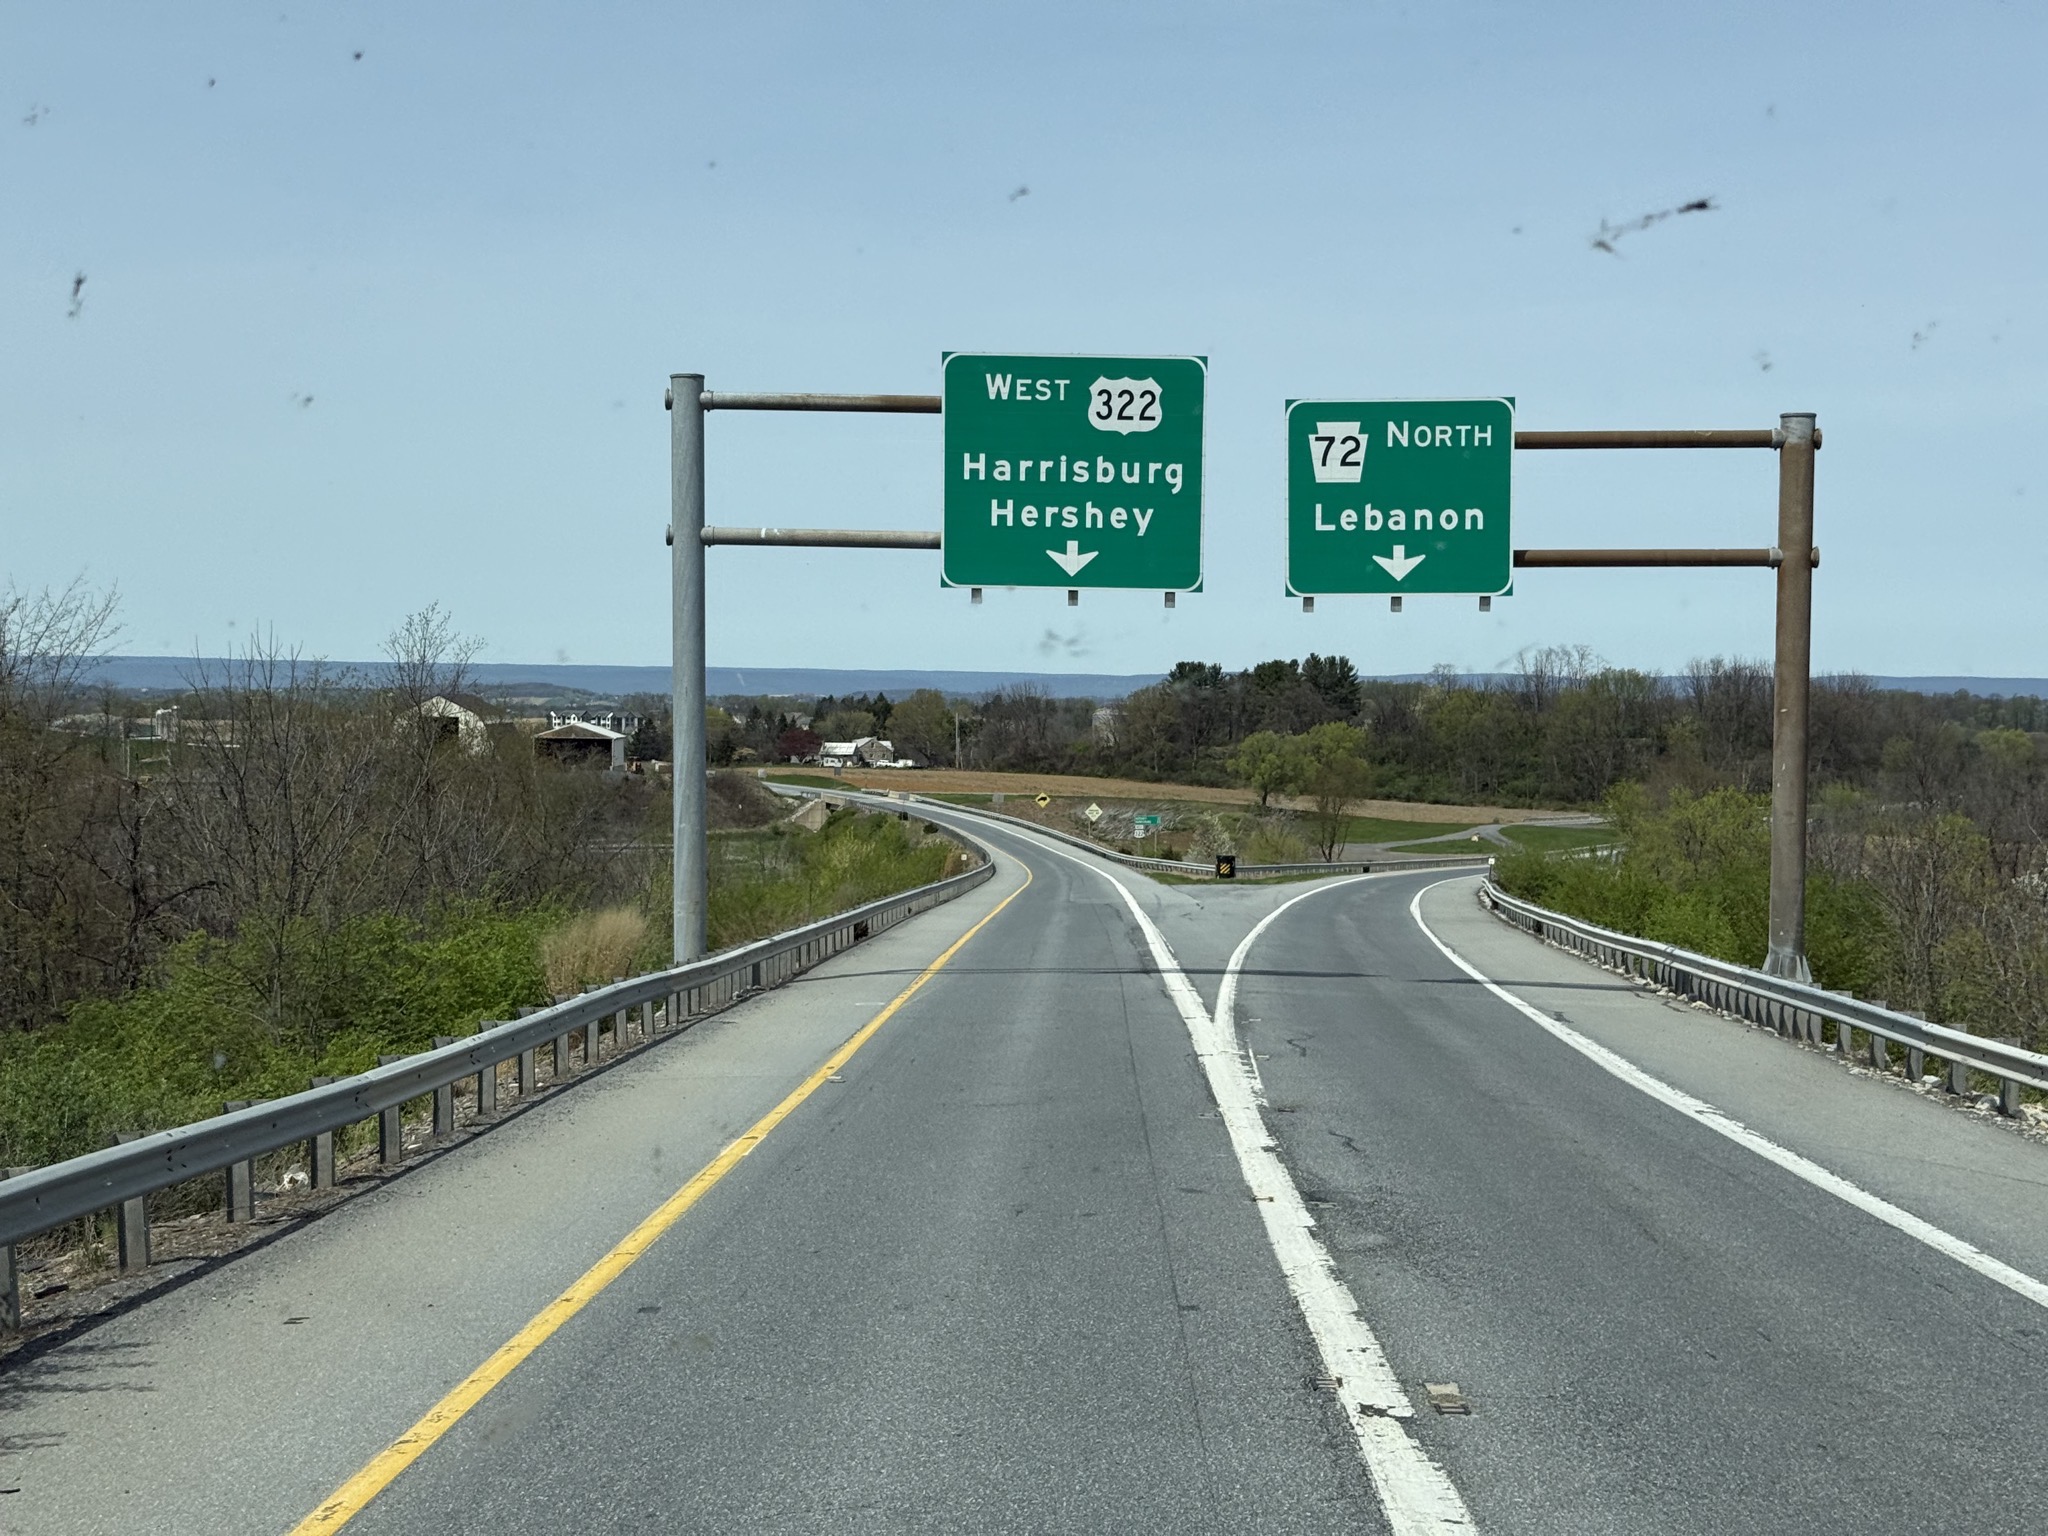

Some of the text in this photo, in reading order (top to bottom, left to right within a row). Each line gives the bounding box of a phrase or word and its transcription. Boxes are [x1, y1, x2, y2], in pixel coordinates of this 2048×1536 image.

[985, 373, 1156, 421] WEST 322
[1314, 421, 1492, 467] 72 NORTH
[963, 453, 1183, 494] Harrisburg
[991, 499, 1154, 536] Hershey
[1315, 503, 1484, 531] Lebanon
